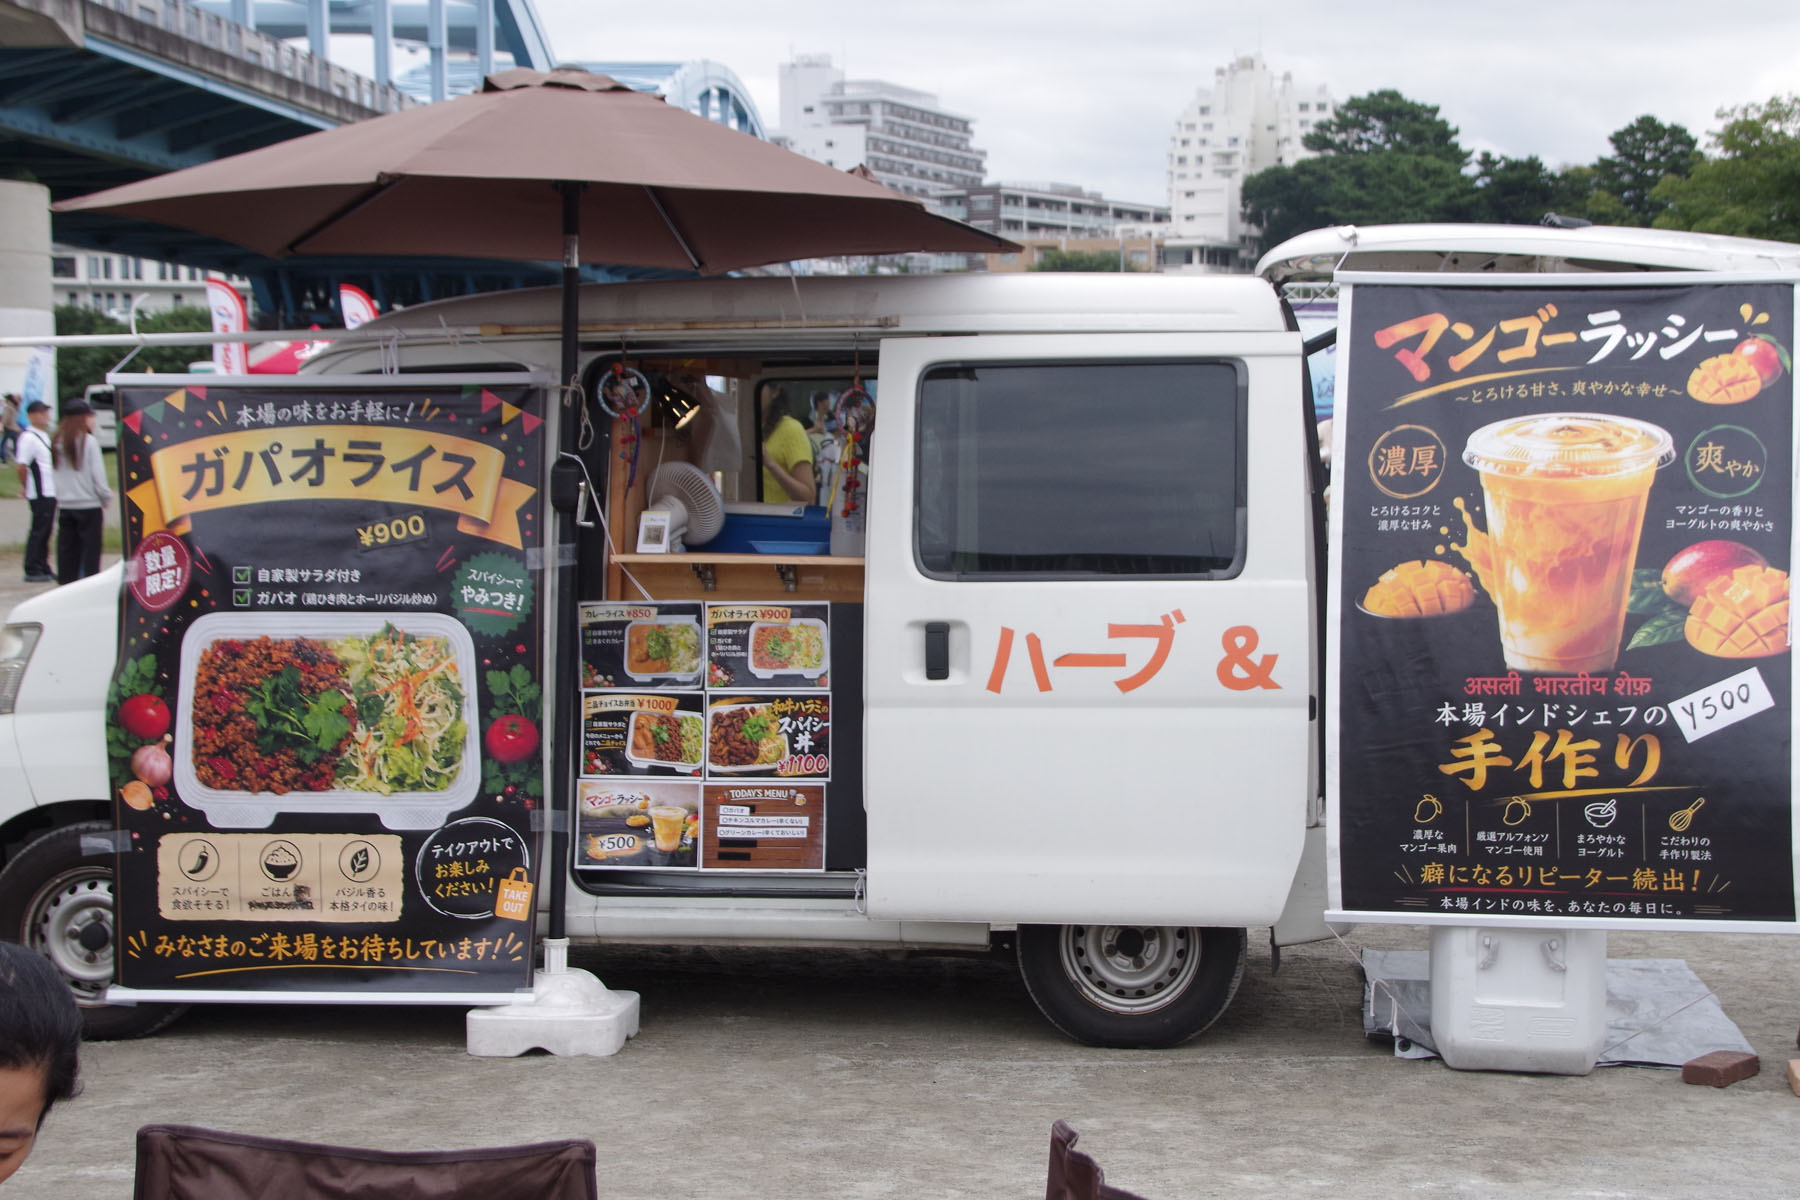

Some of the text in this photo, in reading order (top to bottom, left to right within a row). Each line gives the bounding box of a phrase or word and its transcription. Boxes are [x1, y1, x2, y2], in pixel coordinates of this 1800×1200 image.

[1374, 303, 1739, 383] マンゴーラッシー
[1377, 444, 1439, 478] 濃厚
[1694, 441, 1761, 479] 爽やか
[181, 437, 478, 502] ガパオライス
[1369, 503, 1441, 517] とろけるコクと
[1674, 504, 1765, 518] マンゴーの香りと
[358, 514, 426, 547] ¥900
[1377, 519, 1432, 532] 濃厚な甘み
[1664, 518, 1775, 533] ヨーグルトの爽やかさ
[144, 545, 178, 574] 数量
[257, 567, 362, 583] 自家製サラダ付き
[467, 568, 524, 589] スパイシーで
[460, 585, 525, 611] やみつき!
[584, 608, 652, 618] カレーライス ¥850
[711, 608, 789, 620] ガパオライス ¥900
[986, 608, 1283, 695] ハーブ &
[1463, 671, 1523, 696] असली
[1532, 671, 1609, 696] भारतीय
[637, 698, 672, 711] ¥1000
[771, 697, 829, 715] 和牛ハラミの
[1434, 702, 1668, 728] 本場インドシェフの
[777, 715, 832, 734] スパイシー
[793, 731, 815, 754] 丼
[777, 754, 829, 774] ¥1100
[1438, 728, 1662, 791] 手作り
[586, 793, 644, 807] マンゴーラッシー
[729, 788, 789, 799] TODAY'S MENU
[599, 835, 636, 850] ¥500
[1412, 829, 1444, 841] 濃厚な
[1476, 831, 1549, 843] 厳選アルフォンソ
[1576, 834, 1626, 846] まろやかな
[1660, 835, 1711, 847] こだわりの
[431, 837, 515, 859] テイクアウトで
[1399, 842, 1457, 855] マンゴー果肉
[1485, 844, 1544, 857] マンゴー使用
[1577, 847, 1625, 859] ヨーグルト
[1658, 849, 1712, 861] 手作り製法
[433, 861, 491, 879] お楽しみ
[171, 886, 230, 898] スパイシーで
[336, 887, 386, 898] バジル香る
[434, 878, 495, 899] ください!
[502, 888, 529, 901] TAKE
[502, 901, 526, 915] OUT
[1440, 896, 1685, 916] 本場インドの味を、あなたの毎日に。
